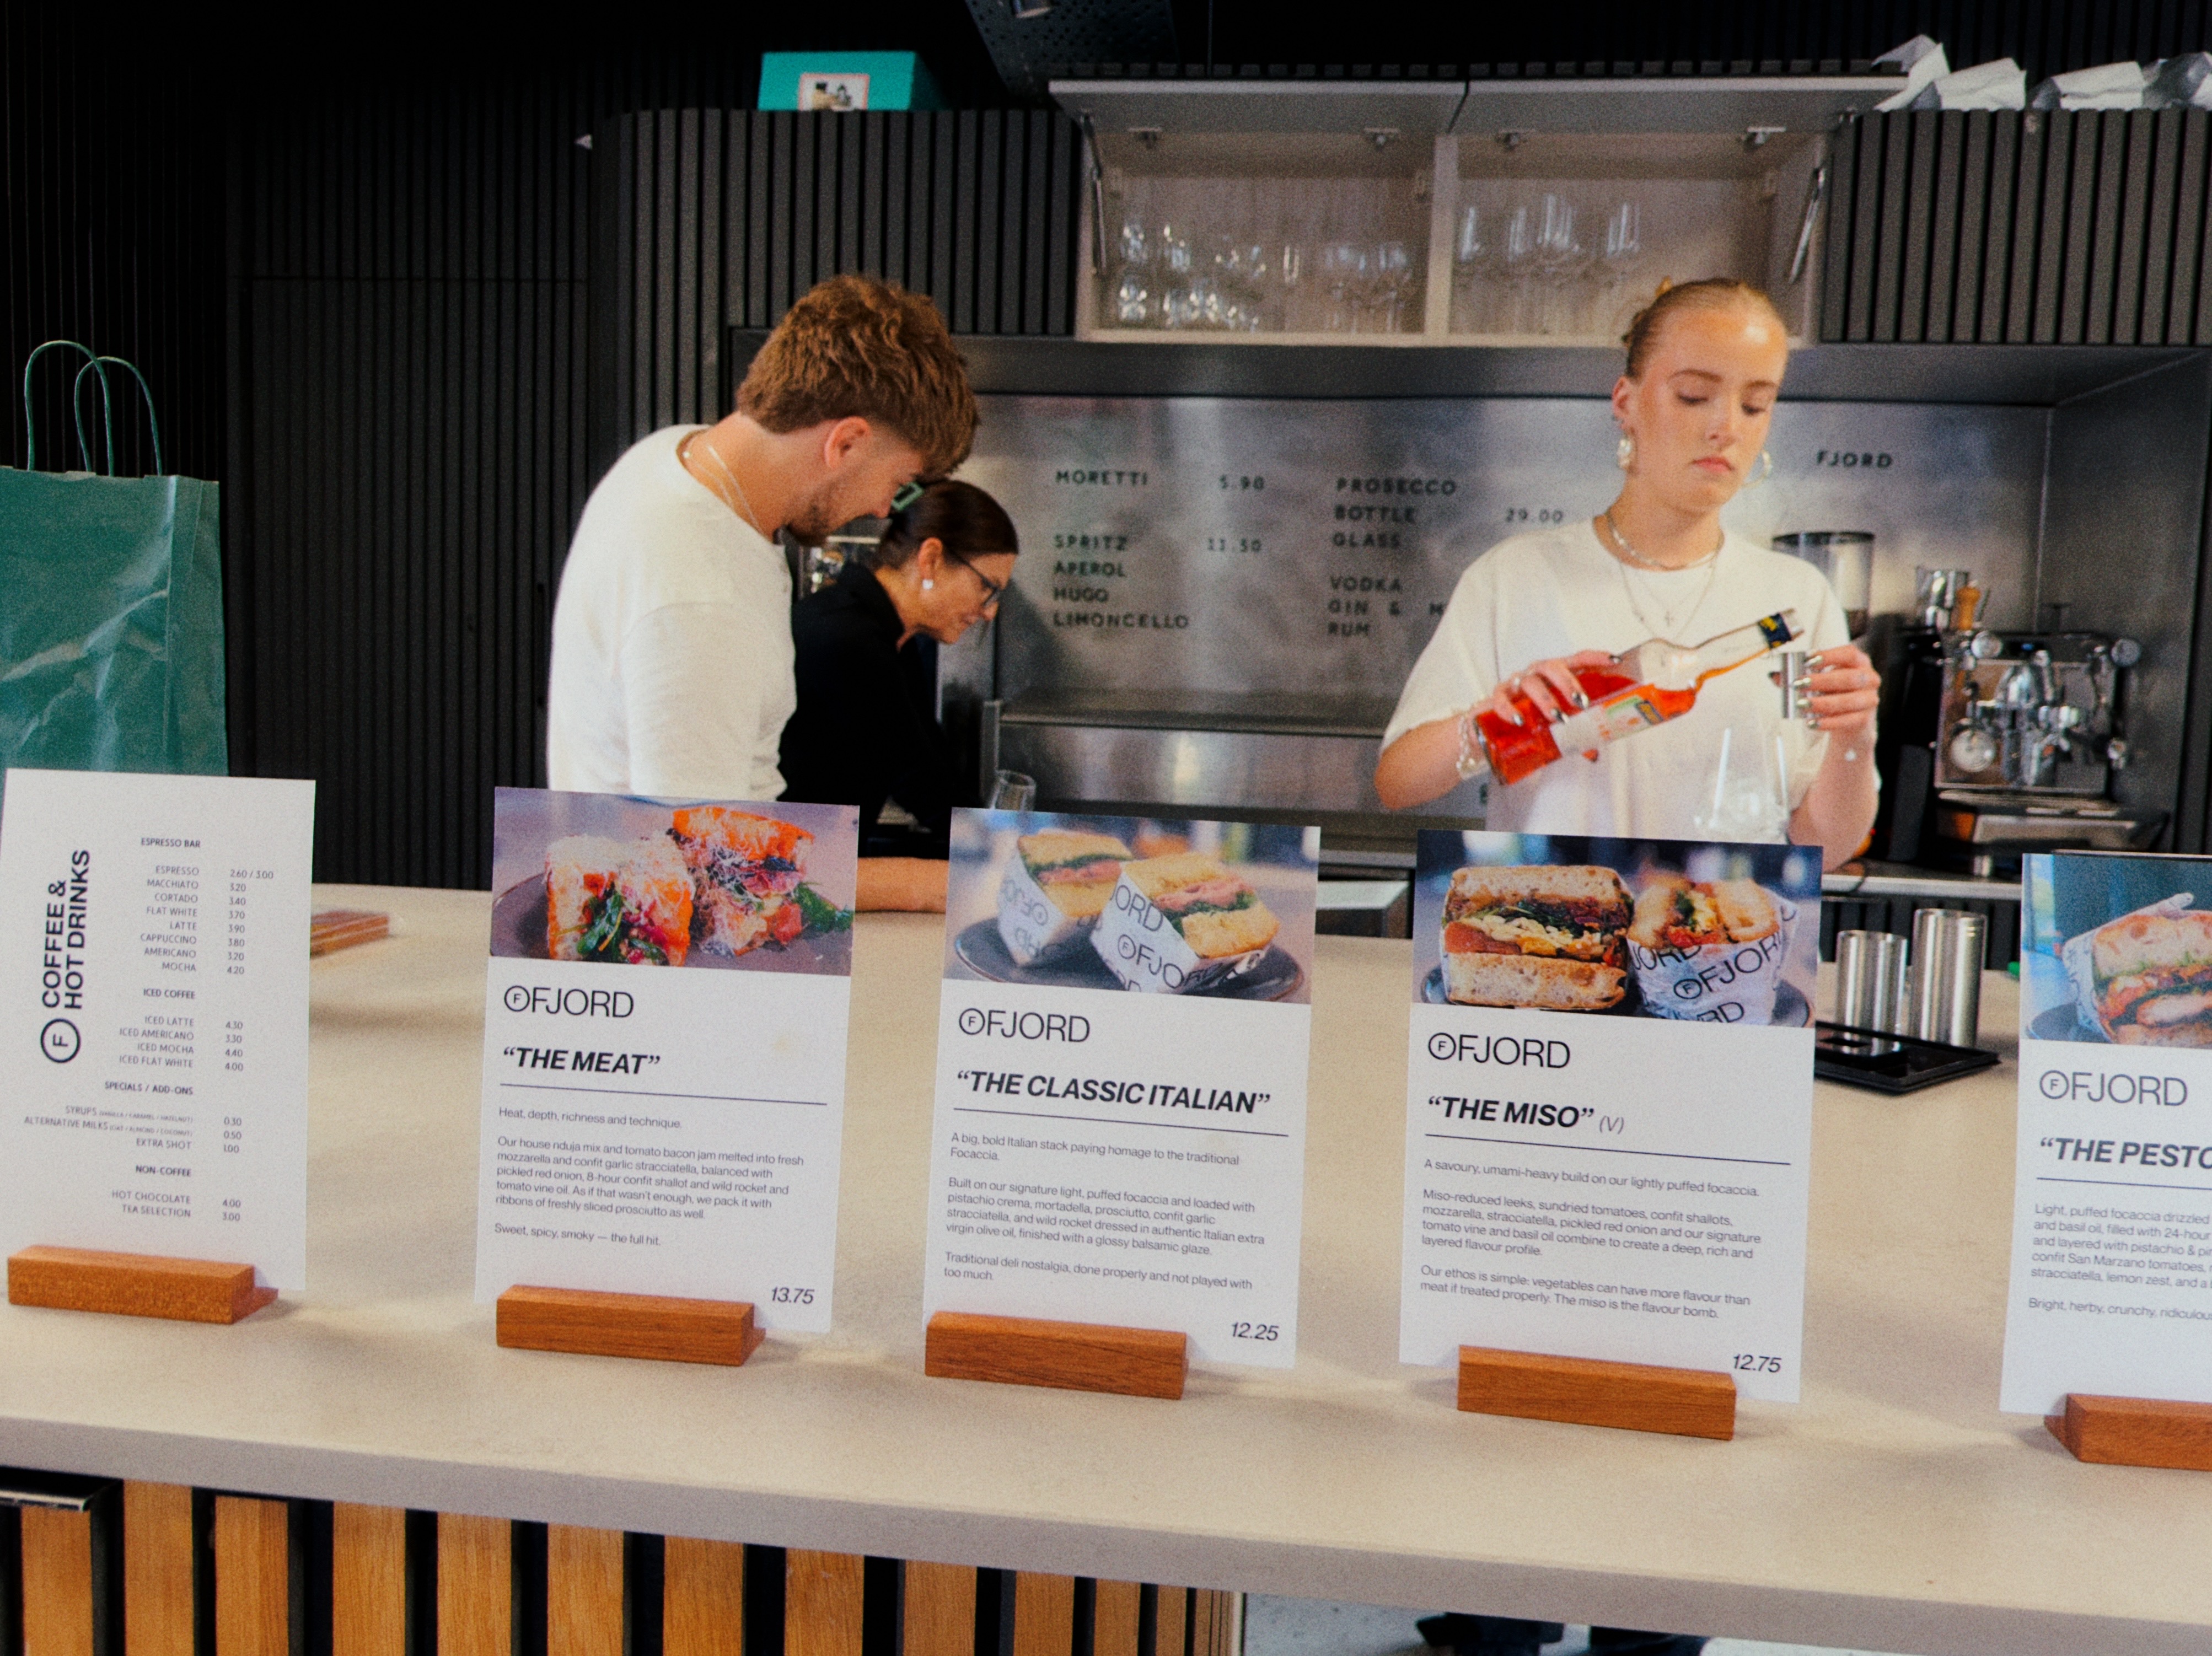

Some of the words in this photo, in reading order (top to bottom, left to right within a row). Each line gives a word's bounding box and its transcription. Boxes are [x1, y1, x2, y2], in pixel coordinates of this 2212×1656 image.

[1817, 449, 1893, 468] FJORD
[1055, 470, 1149, 487] MORETTI
[1335, 477, 1457, 496] PROSECCO
[1334, 506, 1416, 524] BOTTLE
[1054, 533, 1129, 551] SPRITZ
[1333, 533, 1401, 549] GLASS
[1054, 560, 1126, 578] APEROL
[1330, 576, 1403, 593] VODKA
[1054, 587, 1109, 604] HUGO
[1053, 612, 1190, 630] LIMONCELLO
[140, 837, 182, 848] ESPRESSO
[183, 840, 200, 848] BAR
[155, 865, 200, 876] ESPRESSO
[48, 880, 67, 897] &
[146, 879, 200, 889] MACCHIATO
[67, 849, 90, 949] DRINKS
[154, 892, 198, 903] CORTADO
[146, 906, 167, 915] FLAT
[169, 907, 197, 917] WHITE
[169, 921, 196, 931] LATTE
[140, 933, 197, 944] CAPPUCCINO
[42, 902, 65, 1008] COFFEE
[144, 947, 196, 958] AMERICANO
[161, 961, 197, 971] MOCHA
[64, 957, 84, 1010] HOT
[143, 987, 162, 998] ICED
[163, 988, 196, 1000] COFFEE
[531, 987, 635, 1018] FJORD
[144, 1015, 165, 1025] ICED
[167, 1017, 194, 1027] LATTE
[985, 1010, 1091, 1043] FJORD
[119, 1027, 139, 1037] ICED
[141, 1029, 194, 1040] AMERICANO
[137, 1042, 157, 1052] ICED
[159, 1044, 194, 1054] MOCHA
[1457, 1034, 1571, 1069] FJORD
[119, 1054, 139, 1064] ICED
[141, 1056, 162, 1066] FLAT
[165, 1058, 193, 1068] WHITE
[104, 1080, 143, 1092] SPECIALS
[152, 1084, 194, 1095] ADD-ONS
[957, 1071, 1024, 1095] “THE
[1027, 1076, 1146, 1105] CLASSIC
[1148, 1088, 1270, 1114] ITALIAN”
[2071, 1071, 2188, 1106] FJORD
[65, 1105, 97, 1116] SYRUPS
[498, 1107, 525, 1119] Heat,
[527, 1110, 559, 1121] depth,
[561, 1112, 605, 1123] richness
[606, 1115, 627, 1126] and
[629, 1116, 681, 1129] technique.
[24, 1116, 80, 1130] ALTERNATIVE
[82, 1120, 109, 1131] MILKS
[136, 1137, 164, 1148] EXTRA
[166, 1139, 191, 1149] SHOT
[951, 1132, 959, 1142] A
[961, 1133, 980, 1146] big,
[982, 1135, 1006, 1146] bold
[1007, 1137, 1038, 1148] Italian
[1040, 1141, 1069, 1150] stack
[1070, 1144, 1106, 1156] paying
[1108, 1145, 1152, 1159] homage
[1153, 1149, 1165, 1159] to
[1167, 1150, 1184, 1161] the
[1186, 1152, 1240, 1165] traditional
[950, 1146, 1000, 1160] Focaccia.
[135, 1165, 192, 1178] NON-COFFEE
[1424, 1158, 1433, 1169] A
[1435, 1162, 1481, 1174] savoury,
[1483, 1166, 1559, 1181] umami-heavy
[1561, 1171, 1590, 1183] build
[1591, 1175, 1607, 1184] on
[1608, 1177, 1629, 1186] our
[1630, 1176, 1665, 1191] lightly
[1666, 1180, 1705, 1192] puffed
[1707, 1182, 1759, 1197] focaccia.
[111, 1190, 132, 1200] HOT
[135, 1192, 190, 1204] CHOCOLATE
[122, 1203, 138, 1213] TEA
[141, 1206, 191, 1217] SELECTION
[2034, 1204, 2068, 1217] Light,
[2070, 1207, 2108, 1218] puffed
[2111, 1208, 2161, 1221] focaccia
[2163, 1213, 2210, 1224] drizzled
[494, 1222, 528, 1236] Sweet,
[530, 1228, 559, 1239] spicy,
[561, 1230, 595, 1242] smoky
[610, 1232, 628, 1244] the
[629, 1233, 645, 1245] full
[646, 1235, 661, 1246] hit.
[1421, 1235, 1463, 1248] layered
[1465, 1238, 1503, 1252] flavour
[1504, 1244, 1542, 1256] profile.
[944, 1267, 962, 1278] too
[963, 1270, 993, 1280] much.
[770, 1286, 814, 1305] 13.75
[1420, 1282, 1448, 1293] meat
[1450, 1283, 1458, 1293] if
[1460, 1284, 1501, 1298] treated
[1501, 1291, 1550, 1304] properly.
[1554, 1293, 1577, 1305] The
[1578, 1298, 1607, 1309] miso
[1608, 1300, 1619, 1310] is
[1620, 1300, 1640, 1311] the
[1641, 1301, 1681, 1315] flavour
[1683, 1306, 1719, 1319] bomb.
[2028, 1297, 2066, 1311] Bright,
[2069, 1302, 2105, 1314] herby,
[2107, 1305, 2157, 1318] crunchy,
[1231, 1322, 1279, 1341] 12.25
[1732, 1353, 1782, 1373] 12.75
